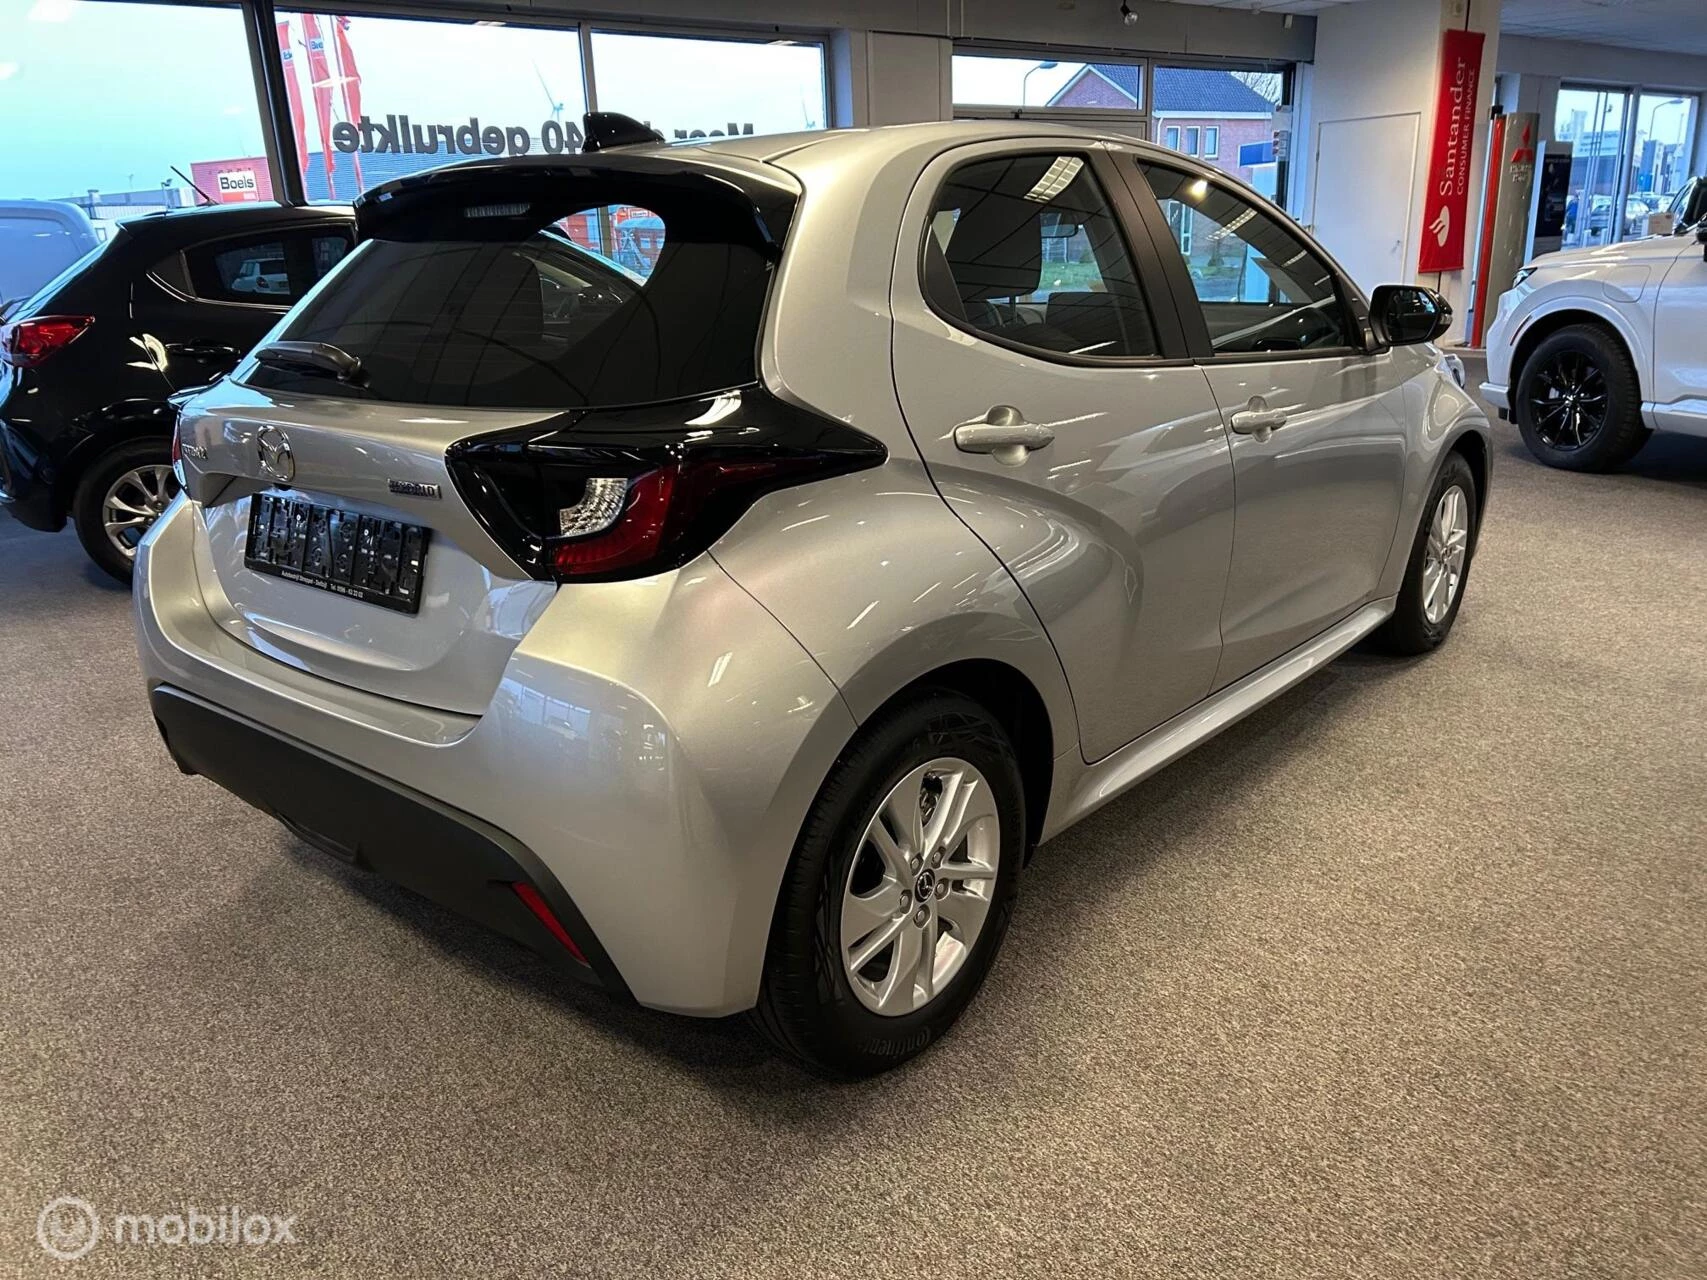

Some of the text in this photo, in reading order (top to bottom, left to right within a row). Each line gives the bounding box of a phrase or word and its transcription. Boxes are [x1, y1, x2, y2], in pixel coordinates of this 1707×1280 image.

[219, 176, 255, 190] Boels
[1440, 57, 1466, 195] Santander
[1457, 68, 1475, 195] CONSUMER FINANCE
